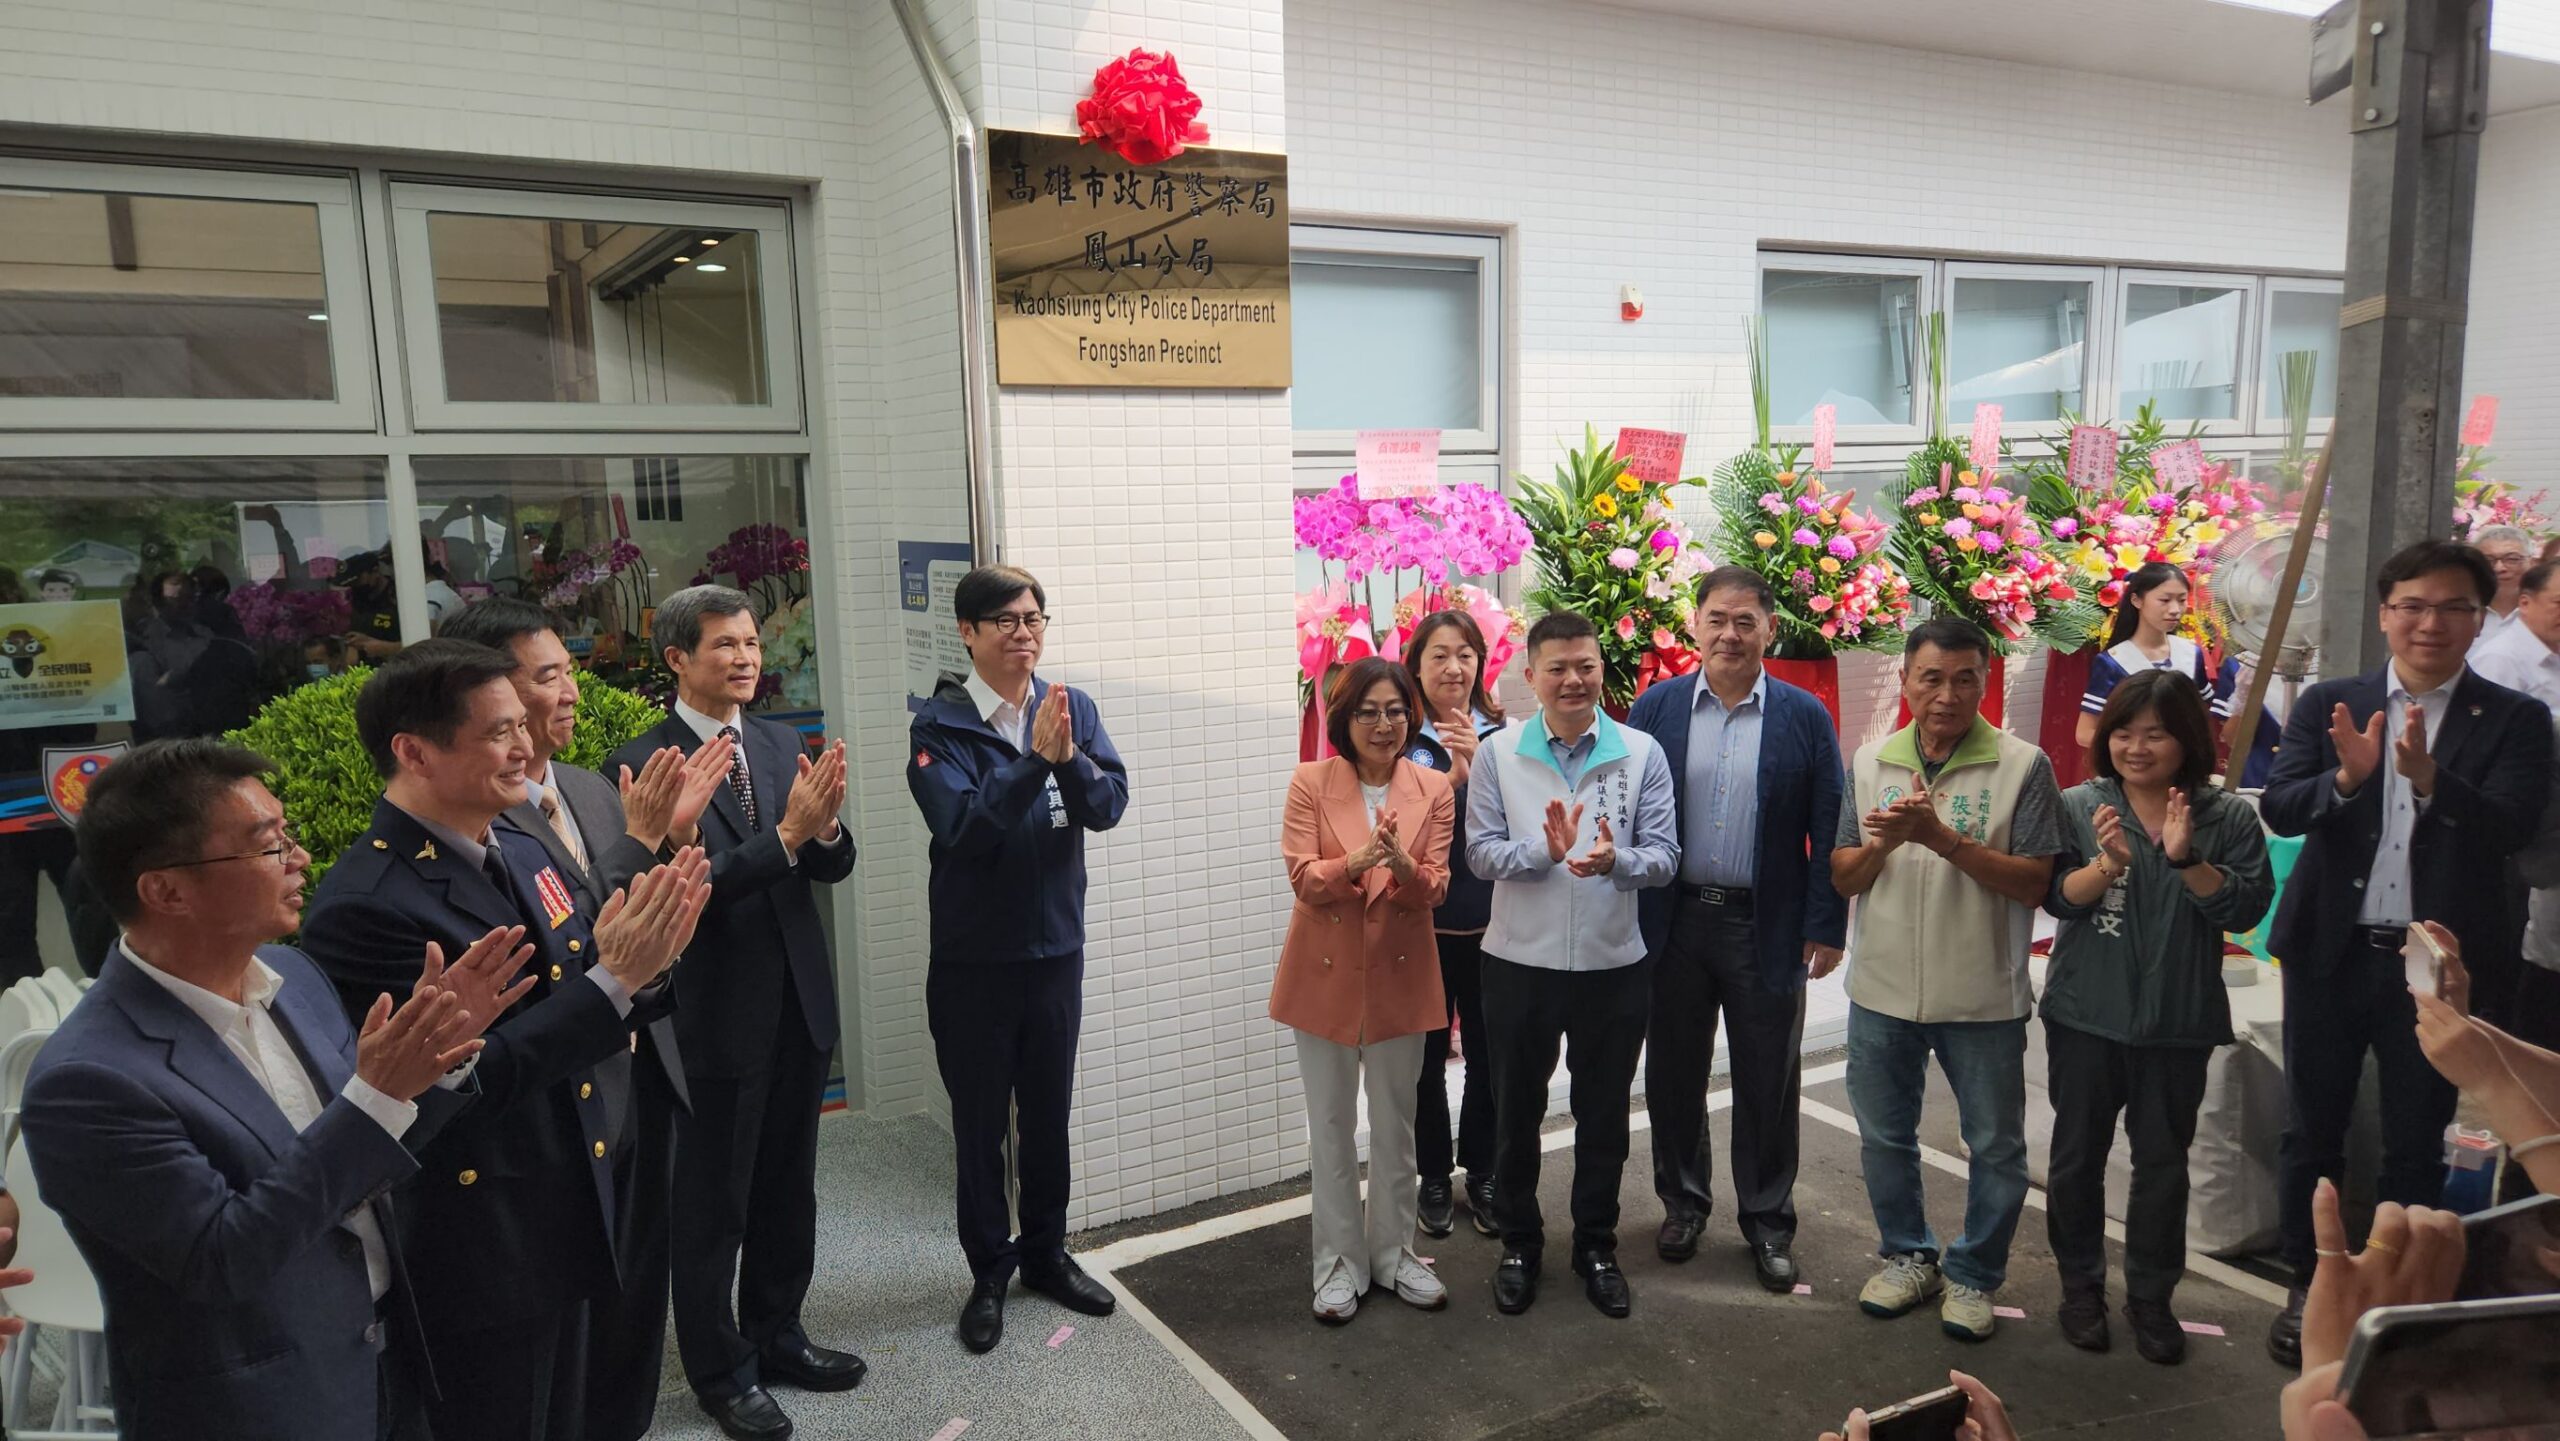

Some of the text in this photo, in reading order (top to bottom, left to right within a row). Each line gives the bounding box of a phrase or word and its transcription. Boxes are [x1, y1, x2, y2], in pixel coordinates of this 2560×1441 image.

[1006, 162, 1276, 219] 高雄市政府警察局
[1085, 231, 1215, 277] 鳳山分局
[1014, 290, 1276, 327] Kaohsiung City Police Department
[1079, 336, 1222, 368] Fongshan Precinct
[1597, 774, 1609, 808] 副議長
[1617, 768, 1629, 829] 高雄市議會
[1974, 789, 1992, 844] 高雄市議
